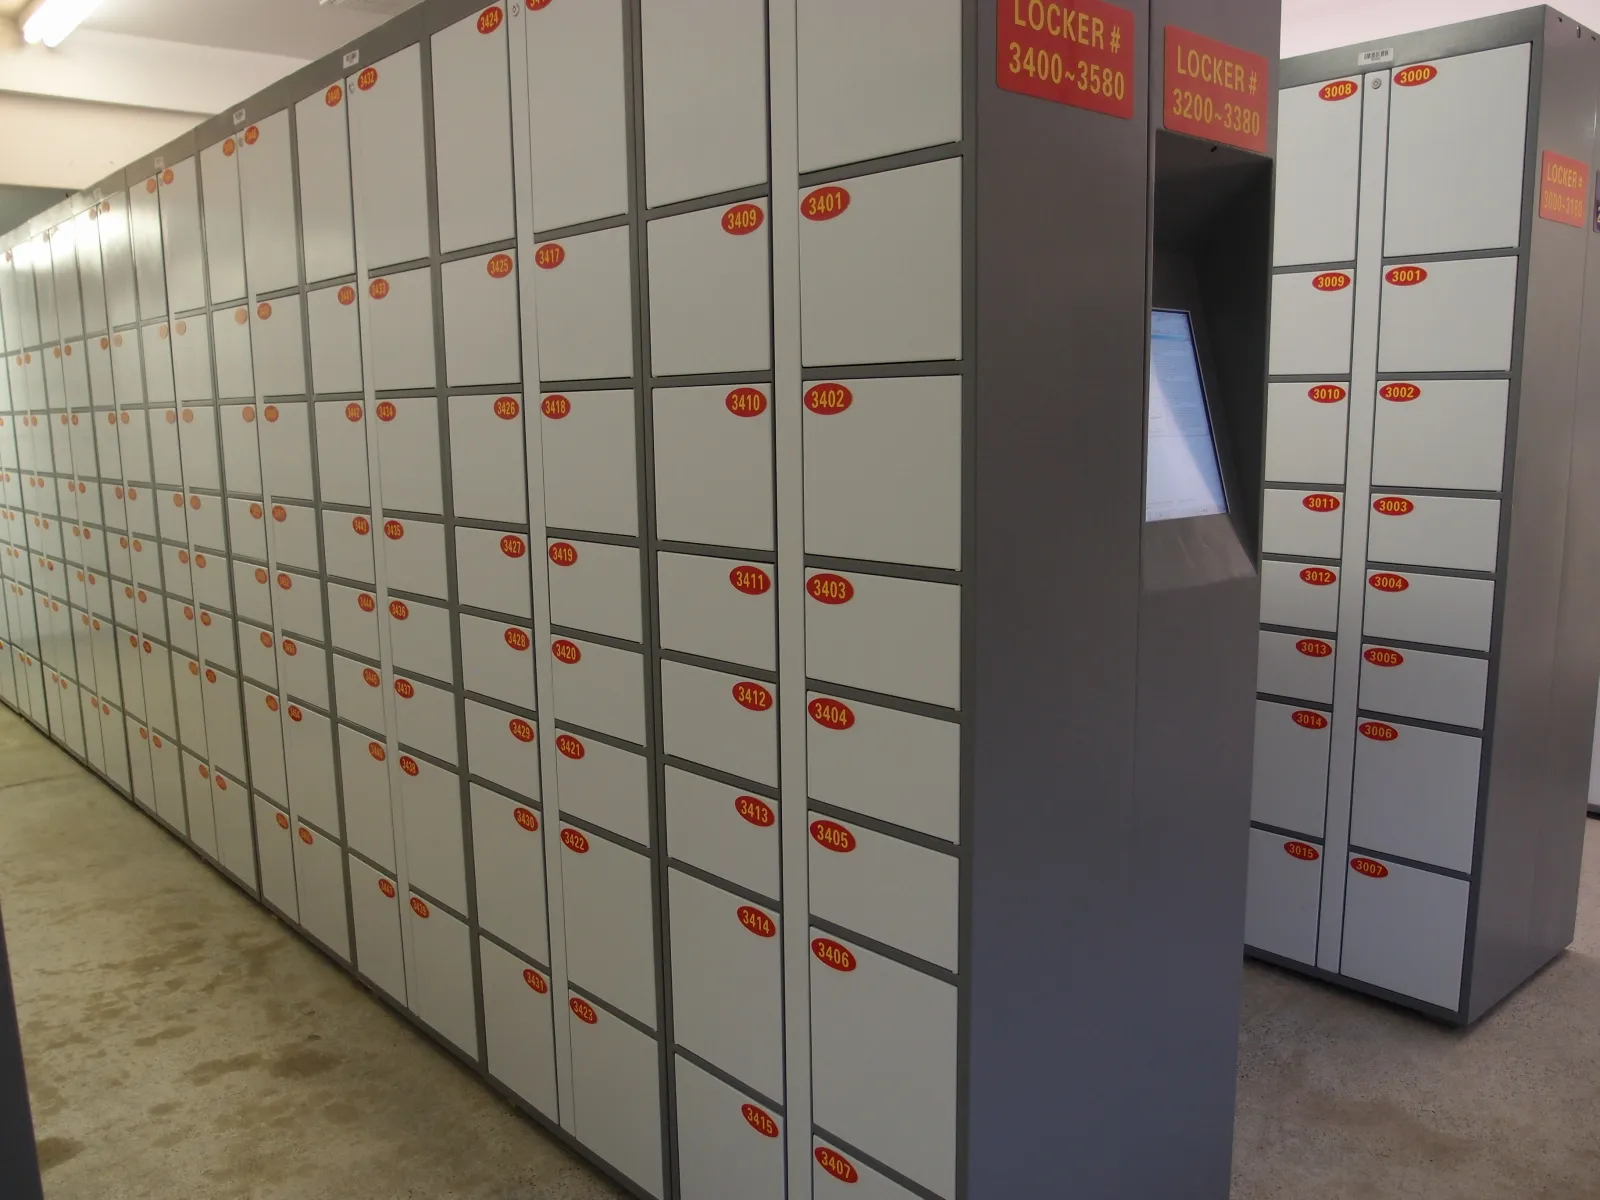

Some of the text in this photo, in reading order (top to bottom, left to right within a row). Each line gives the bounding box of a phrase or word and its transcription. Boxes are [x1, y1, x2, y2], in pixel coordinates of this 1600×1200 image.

[481, 10, 499, 31] 3424
[1014, 0, 1121, 54] LOCKER #
[1009, 41, 1125, 101] 3400~3580
[1176, 44, 1258, 95] LOCKER #
[1400, 68, 1430, 84] 3000
[1325, 84, 1351, 99] 3008
[1172, 88, 1260, 137] 3200~3380
[1547, 163, 1577, 188] LOCKER
[809, 192, 840, 216] 3401
[728, 209, 756, 230] 3409
[540, 248, 560, 265] 3417
[491, 259, 509, 275] 3425
[1318, 276, 1344, 289] 3009
[1392, 270, 1420, 283] 3001
[812, 390, 844, 409] 3402
[1314, 389, 1339, 400] 3010
[1386, 387, 1414, 398] 3002
[498, 402, 516, 415] 3426
[546, 400, 566, 415] 3418
[732, 394, 760, 411] 3410
[1309, 498, 1333, 509] 3011
[1380, 501, 1407, 513] 3003
[504, 540, 521, 554] 3427
[553, 547, 573, 562] 3419
[737, 571, 762, 591] 3411
[1305, 571, 1330, 583] 3012
[1375, 577, 1402, 589] 3004
[814, 580, 845, 599] 3403
[508, 632, 526, 648] 3428
[1302, 642, 1326, 655] 3013
[556, 644, 577, 661] 3420
[1370, 651, 1396, 665] 3005
[739, 686, 765, 708] 3412
[815, 703, 846, 726] 3404
[1297, 713, 1321, 727] 3014
[513, 722, 531, 740] 3429
[1365, 725, 1392, 739] 3006
[561, 739, 580, 757] 3421
[517, 811, 535, 829] 3430
[741, 800, 767, 823] 3413
[565, 832, 585, 851] 3422
[818, 824, 848, 849] 3405
[1290, 845, 1315, 858] 3015
[1356, 860, 1382, 876] 3007
[743, 910, 769, 935] 3414
[818, 942, 849, 968] 3406
[527, 972, 544, 991] 3431
[574, 1001, 593, 1022] 3423
[747, 1108, 773, 1134] 3415
[822, 1151, 850, 1179] 3407
